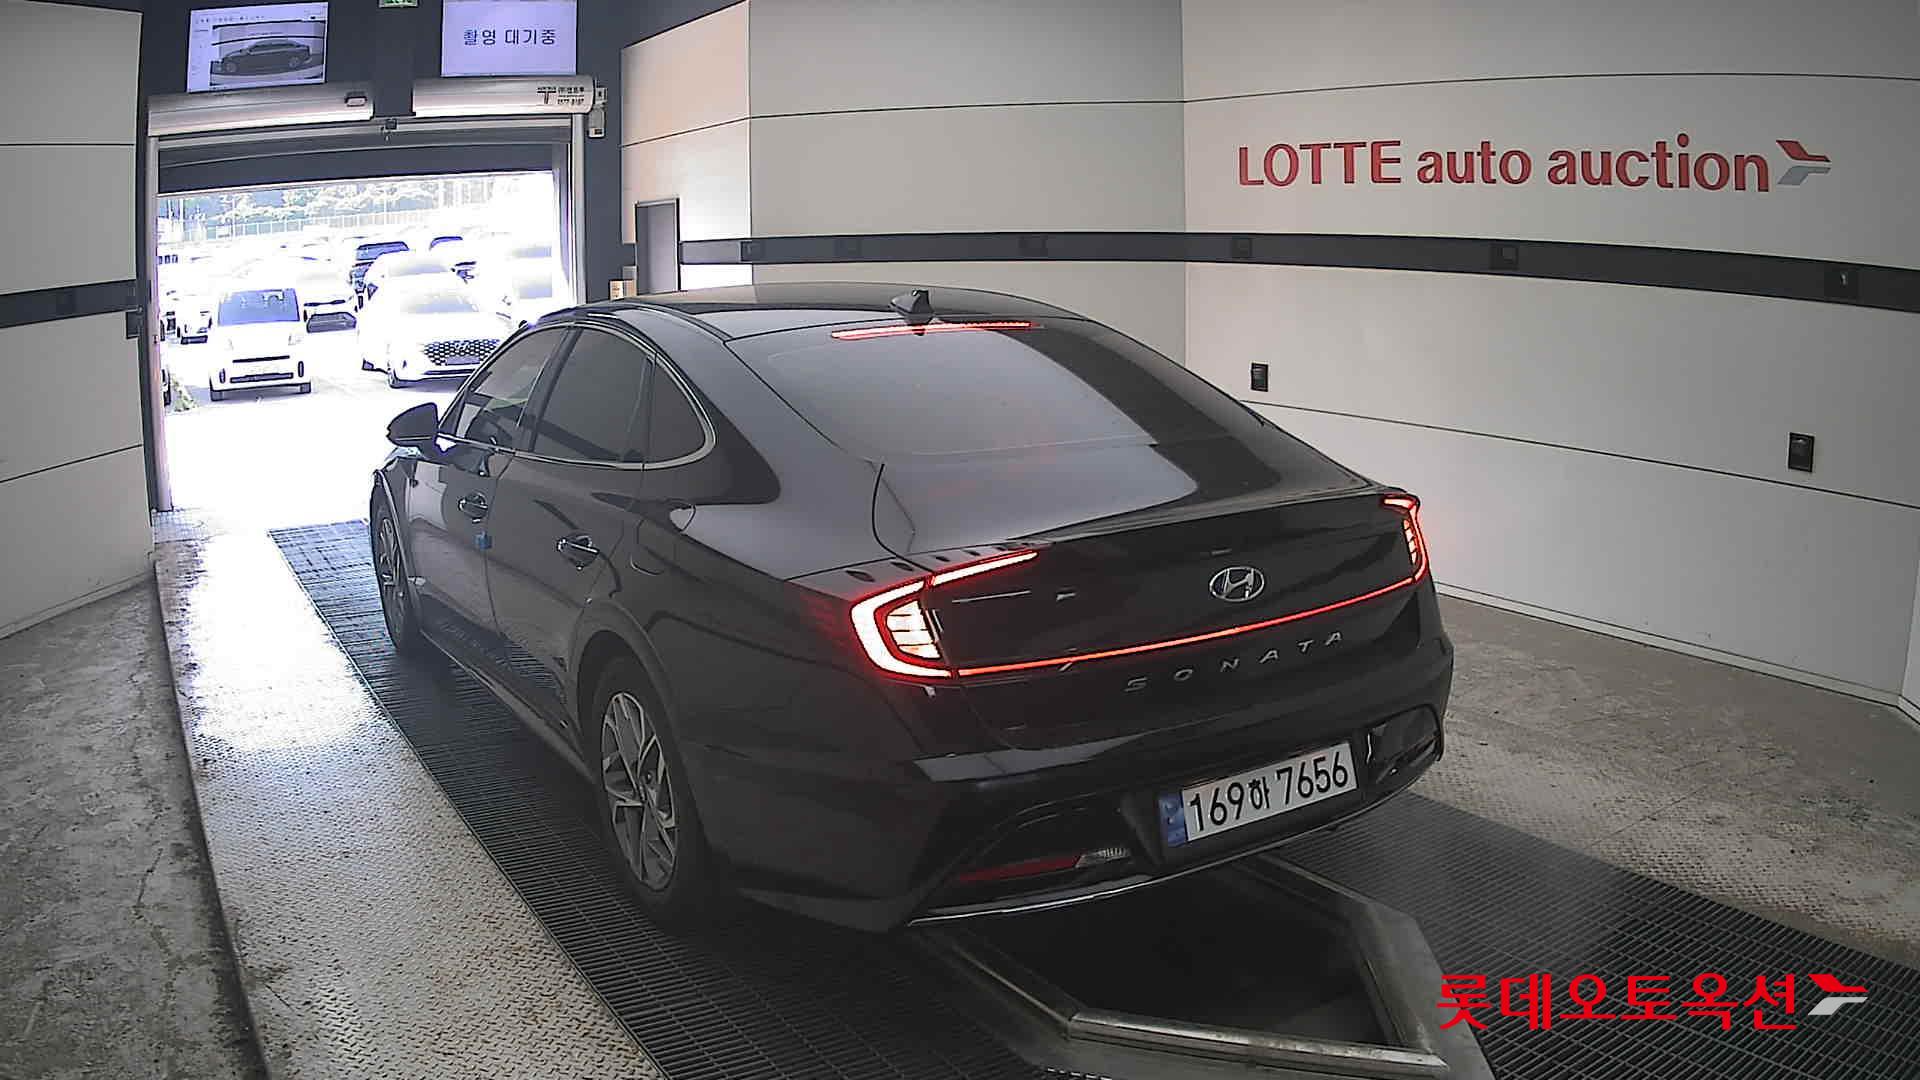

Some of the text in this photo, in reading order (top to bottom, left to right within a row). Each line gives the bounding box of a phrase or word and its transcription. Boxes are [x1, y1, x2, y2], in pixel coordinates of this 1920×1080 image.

[464, 29, 555, 45] 촬영 대기중
[1239, 133, 1769, 192] LOTTE auto auction
[1124, 631, 1342, 692] SONATA
[1188, 751, 1348, 831] 169하 7656
